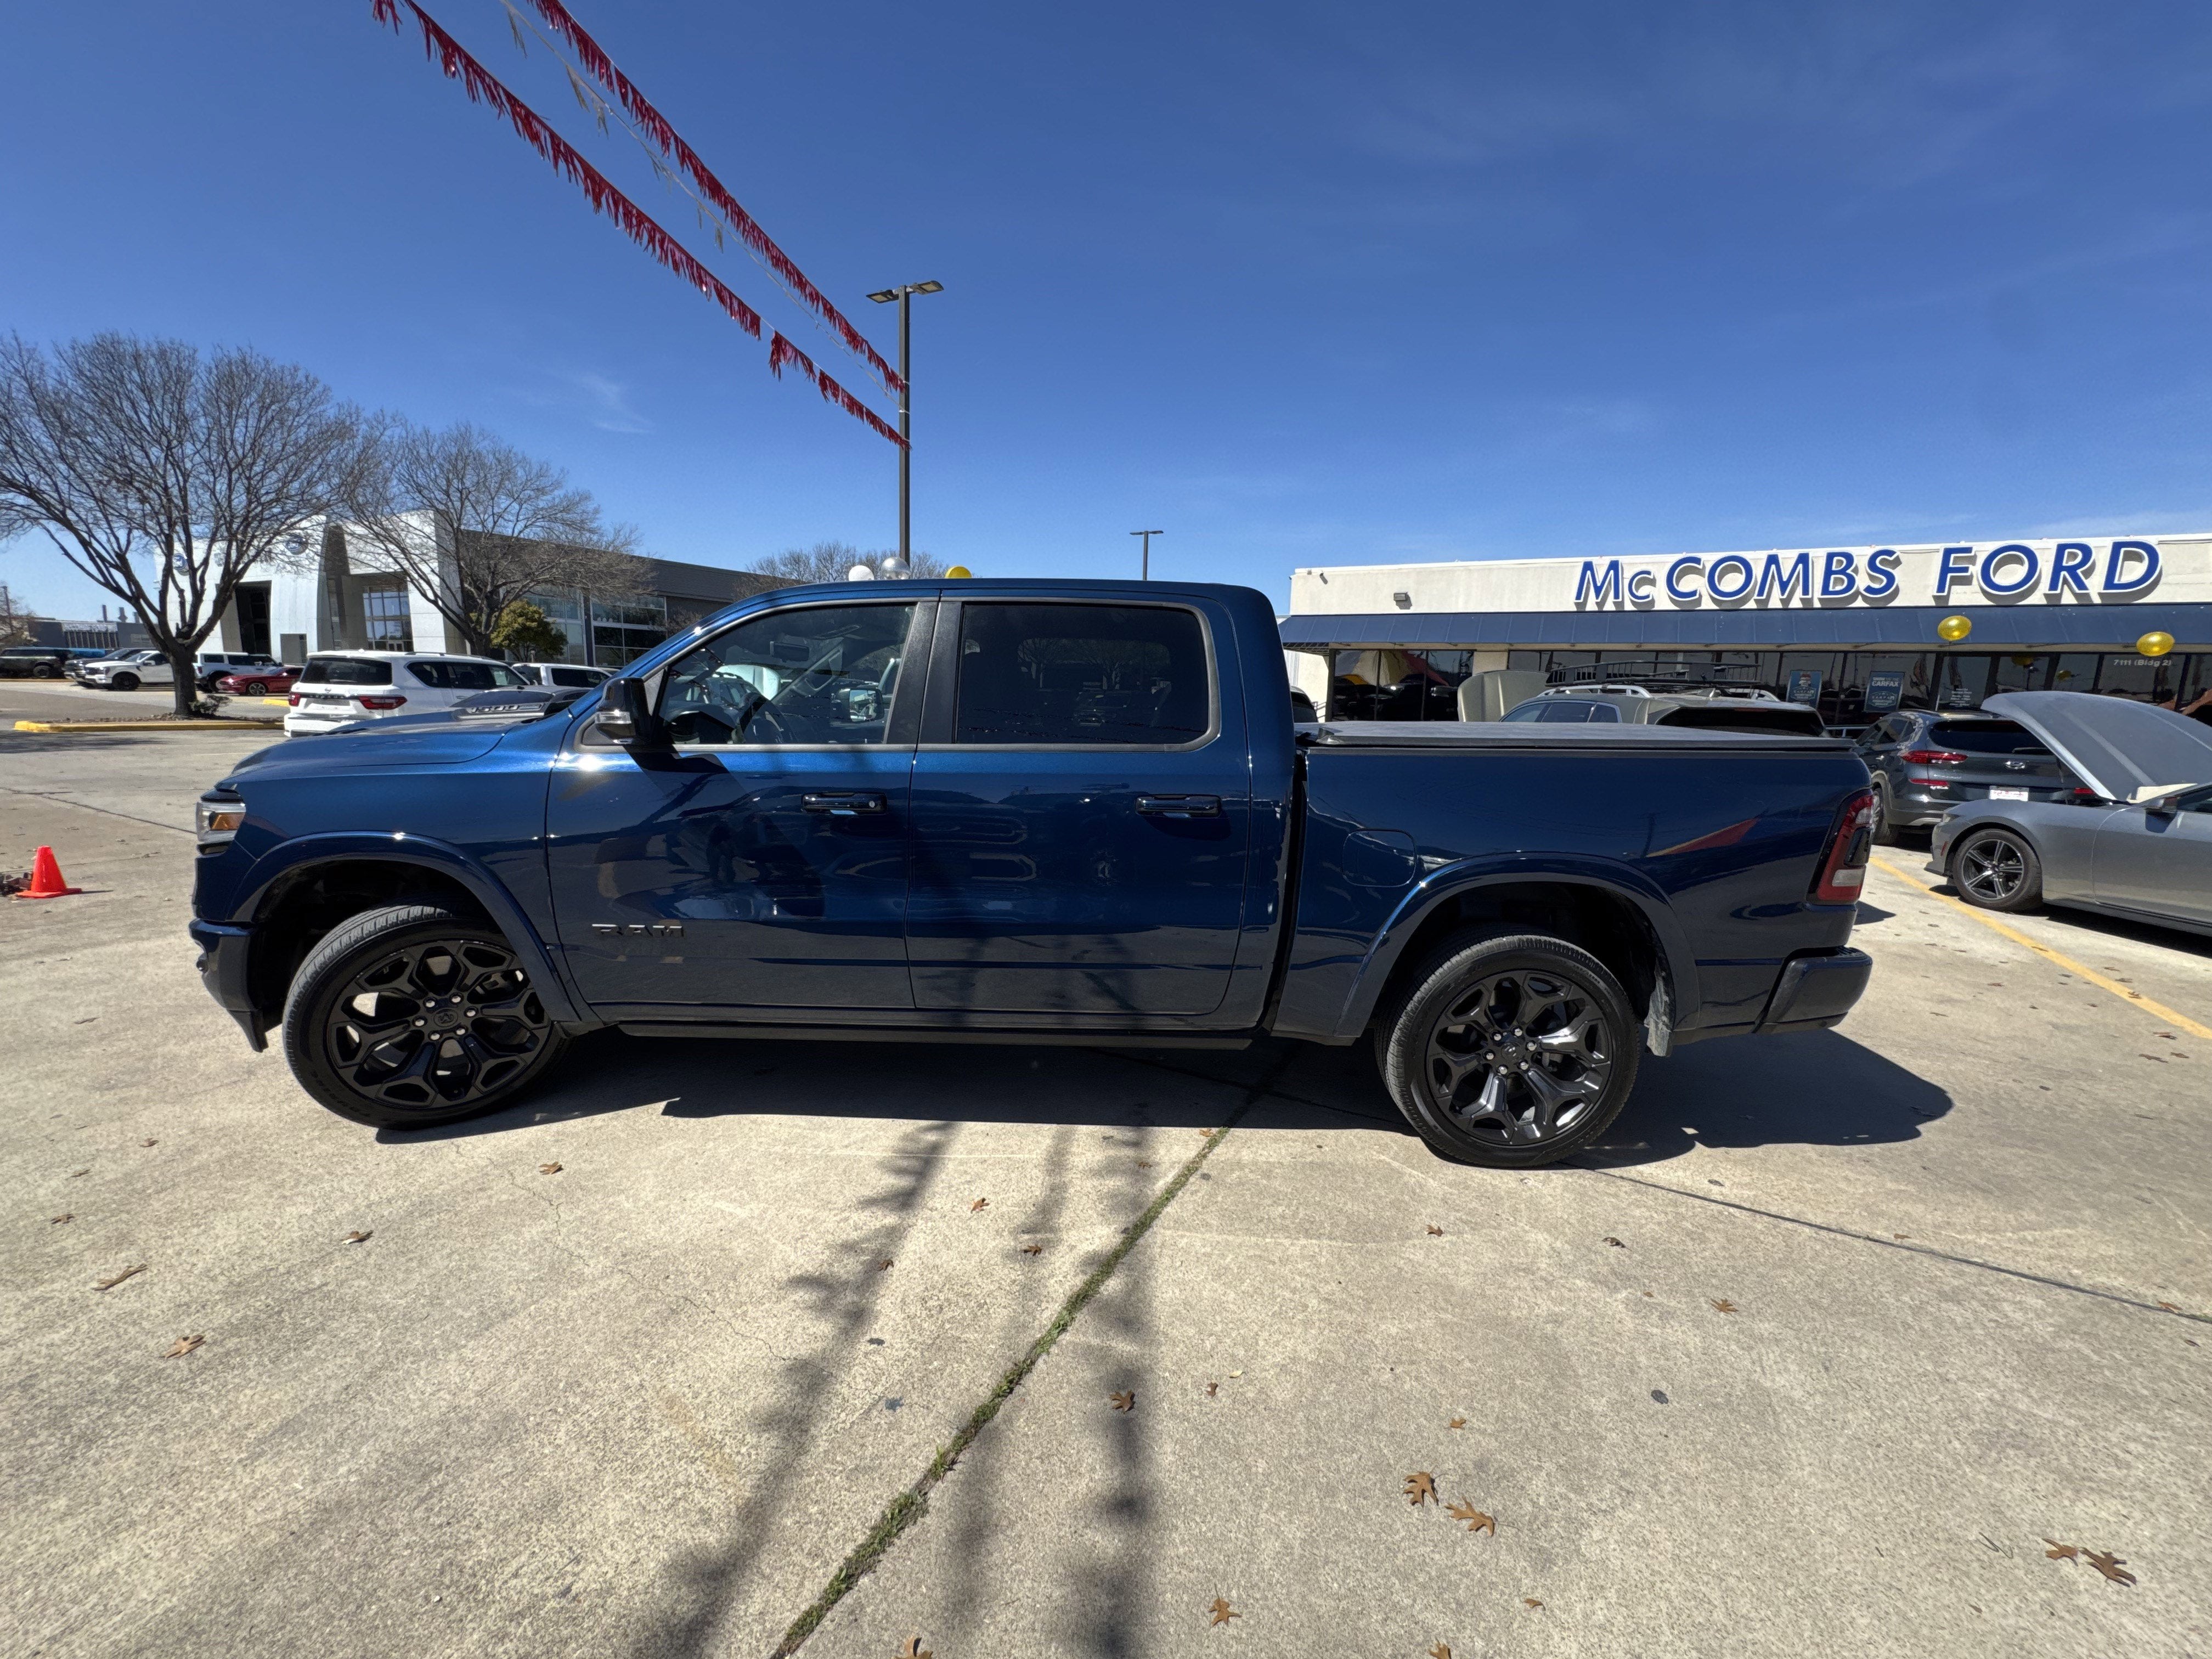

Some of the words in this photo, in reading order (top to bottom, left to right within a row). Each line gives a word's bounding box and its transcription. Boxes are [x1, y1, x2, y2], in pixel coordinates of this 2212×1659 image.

[1574, 548, 1900, 602] McCOMBS
[1933, 539, 2162, 596] FORD
[471, 704, 519, 713] 1500
